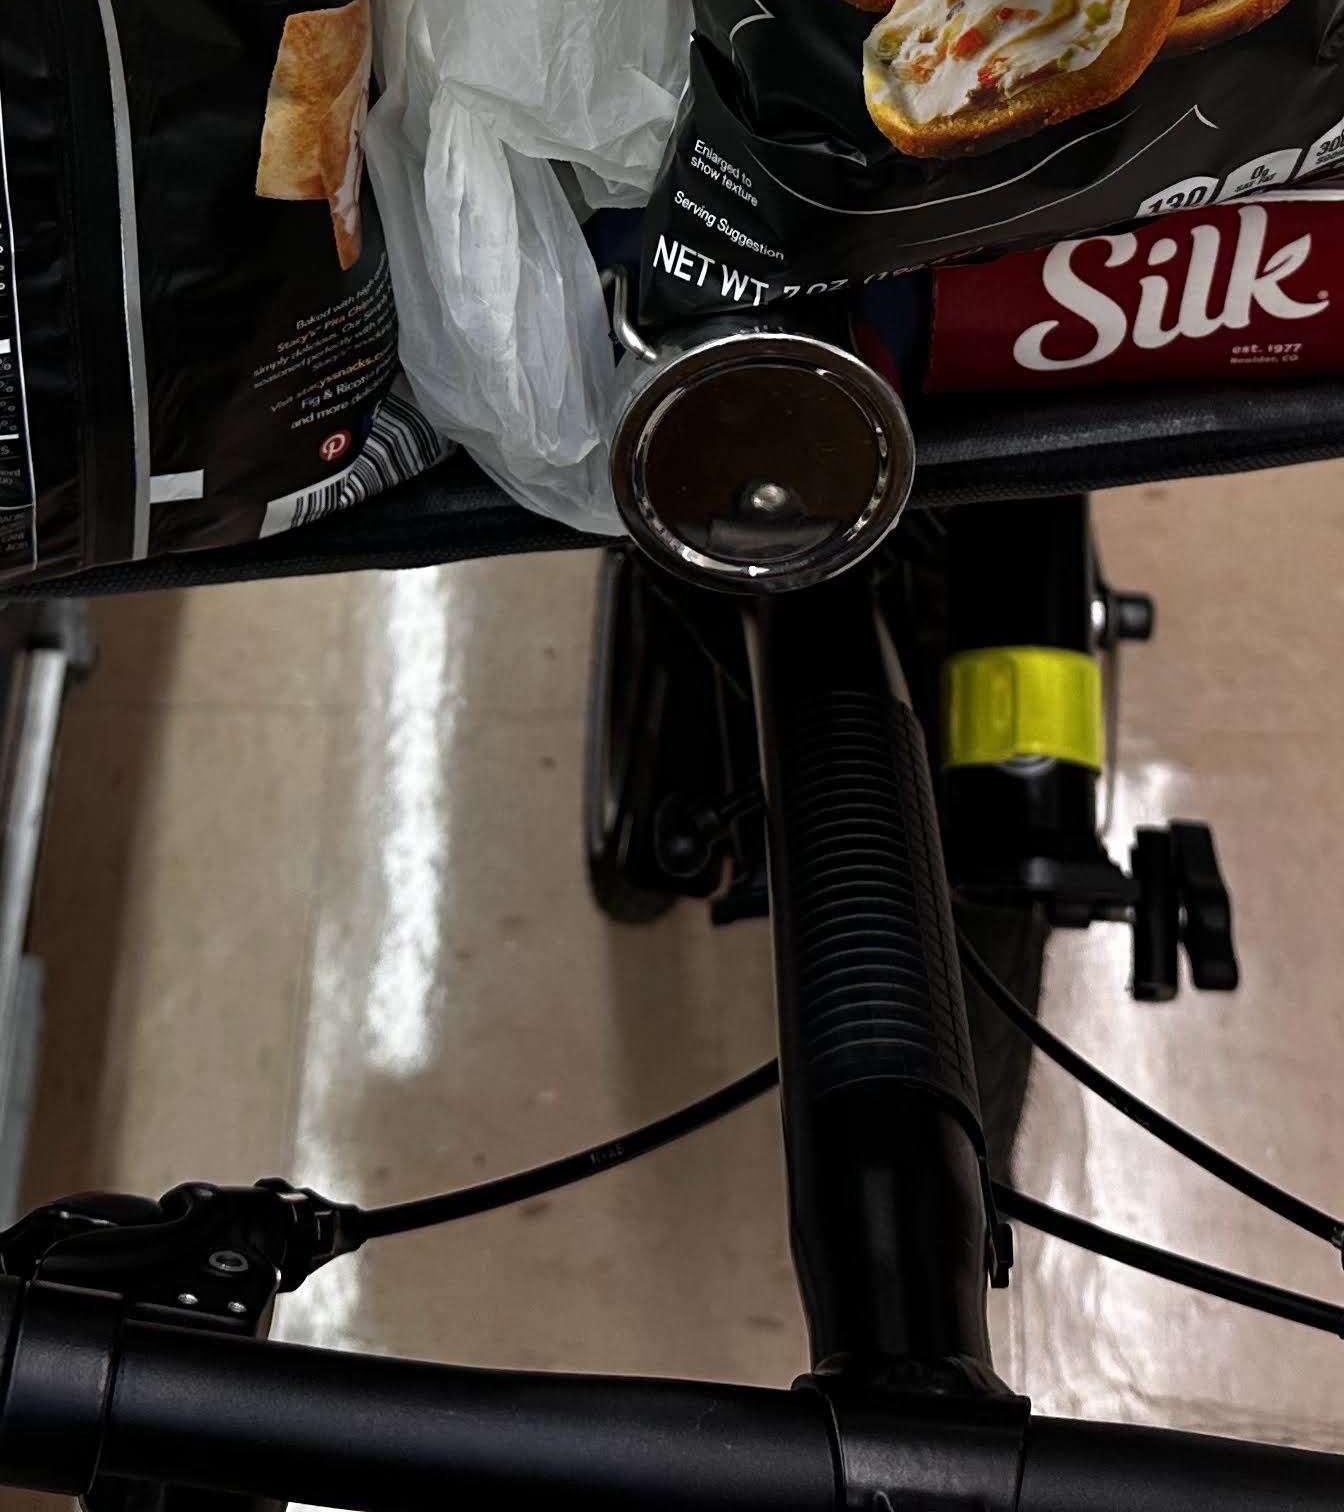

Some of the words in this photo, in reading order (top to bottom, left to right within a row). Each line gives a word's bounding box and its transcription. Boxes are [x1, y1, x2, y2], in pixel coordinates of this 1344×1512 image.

[690, 155, 721, 181] show
[722, 175, 759, 208] texture
[694, 139, 741, 180] Enlarged
[741, 173, 752, 188] to
[674, 190, 717, 227] Serving
[717, 218, 786, 261] Suggestion
[653, 234, 716, 288] NET
[721, 263, 770, 307] WT
[1012, 205, 1330, 372] Silk
[1232, 343, 1263, 355] est.
[1267, 342, 1304, 355] 1977
[291, 411, 315, 430] and
[317, 400, 350, 420] more
[302, 396, 322, 410] Fig
[323, 388, 334, 401] &
